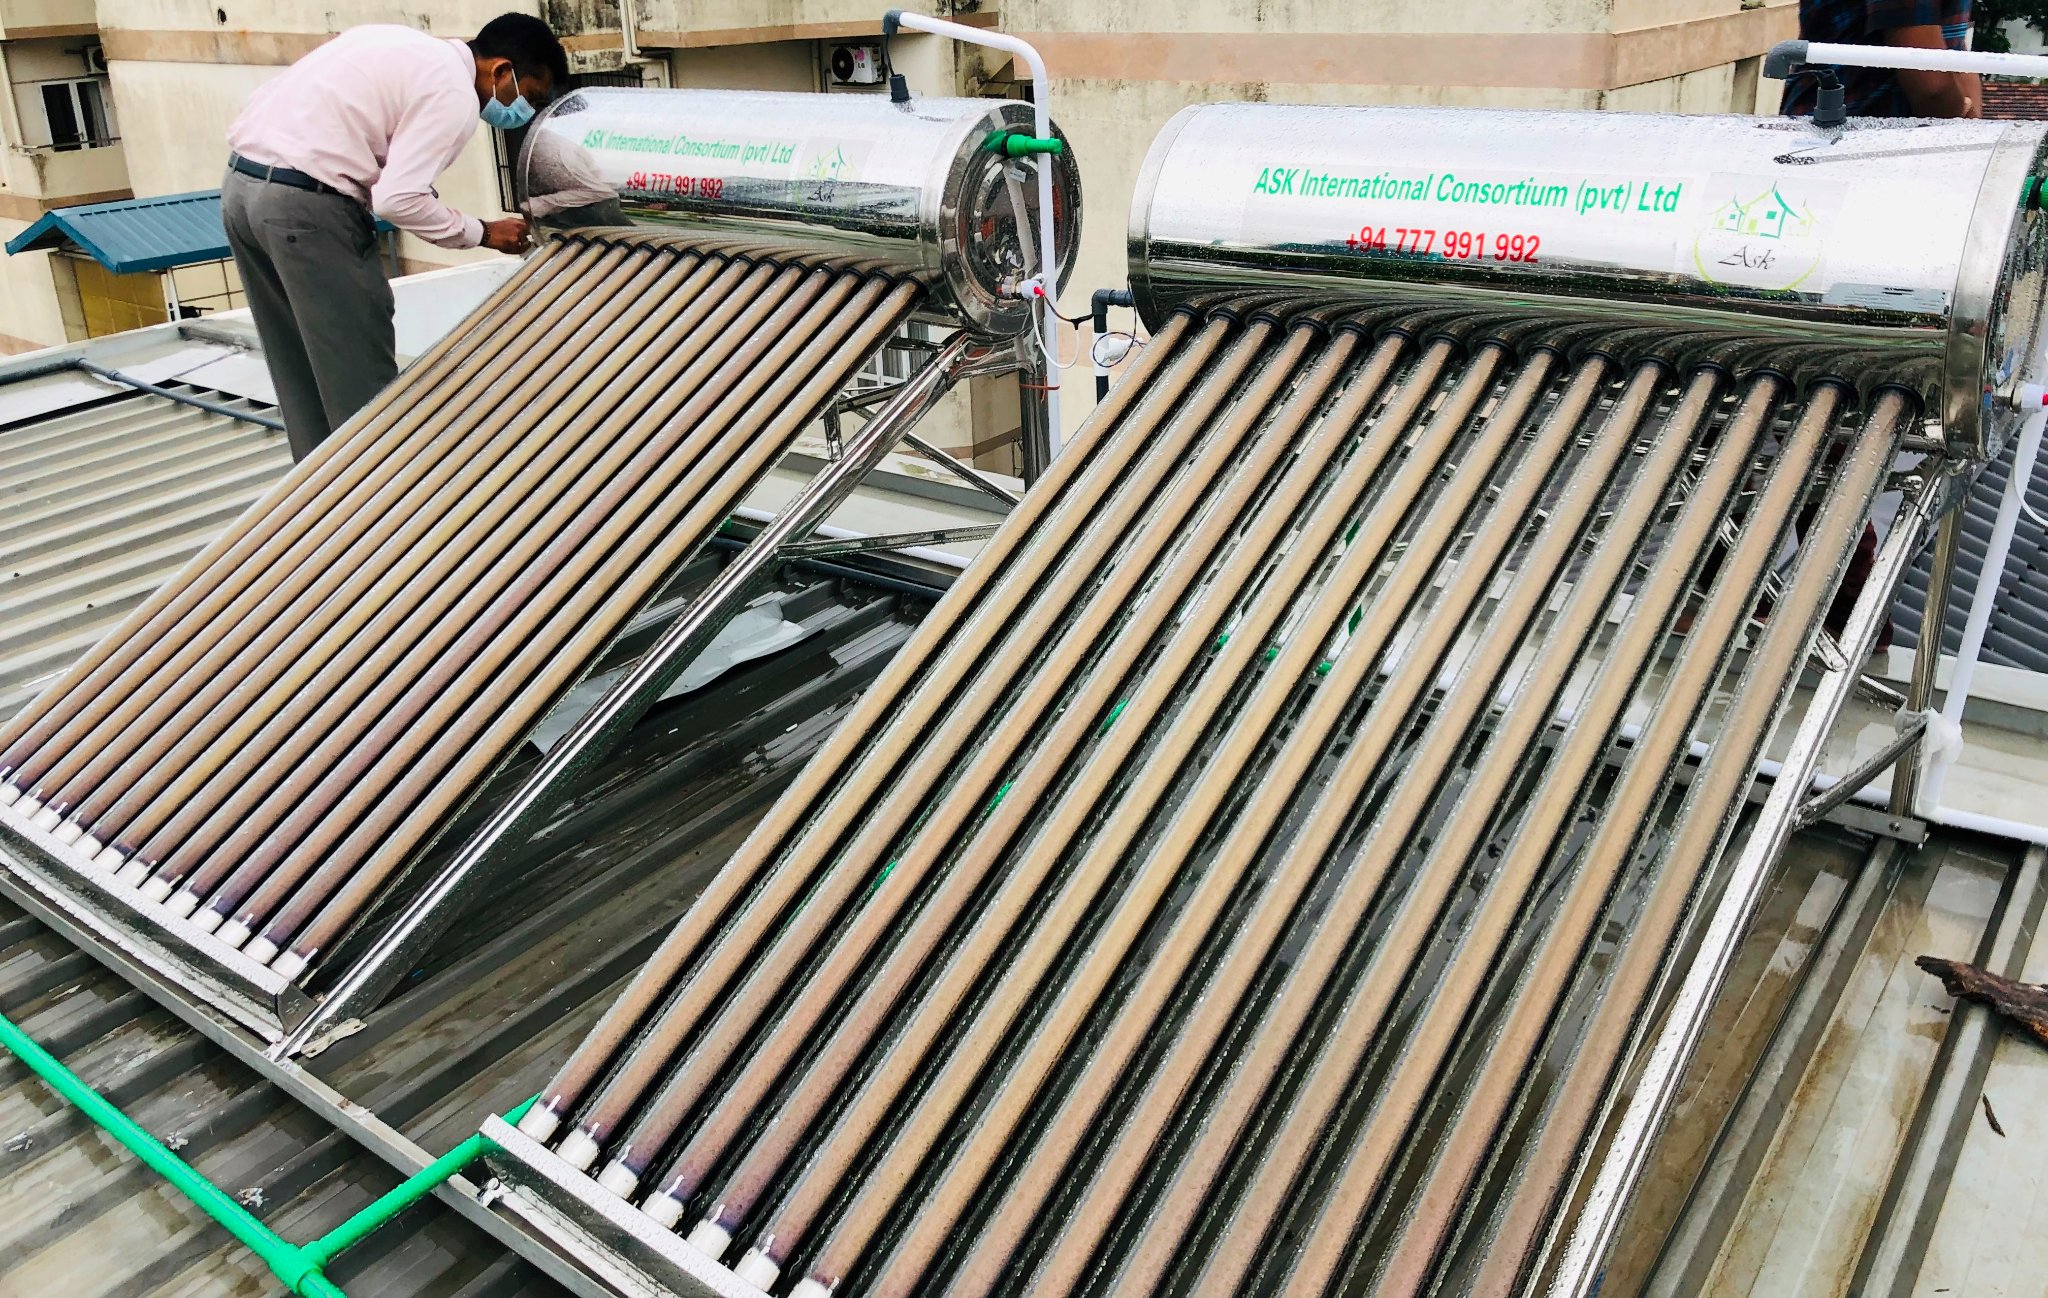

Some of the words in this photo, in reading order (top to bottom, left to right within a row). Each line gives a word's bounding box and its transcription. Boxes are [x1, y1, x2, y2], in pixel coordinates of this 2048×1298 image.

[583, 129, 609, 149] ASK
[605, 130, 676, 155] International
[675, 135, 741, 160] Consortium
[742, 140, 773, 165] (pvt)
[771, 142, 797, 164] Ltd
[626, 171, 647, 191] +94
[651, 173, 672, 192] 777
[674, 175, 696, 196] 991
[700, 177, 723, 199] 992
[1253, 167, 1299, 196] ASK
[1299, 168, 1434, 201] International
[1436, 173, 1569, 208] Consortium
[1575, 178, 1633, 216] (pvt)
[1637, 181, 1683, 213] Ltd
[1345, 225, 1387, 254] +94
[1395, 227, 1437, 256] 777
[1443, 230, 1486, 260] 991
[1494, 233, 1542, 264] 992
[1718, 244, 1776, 270] Ask
